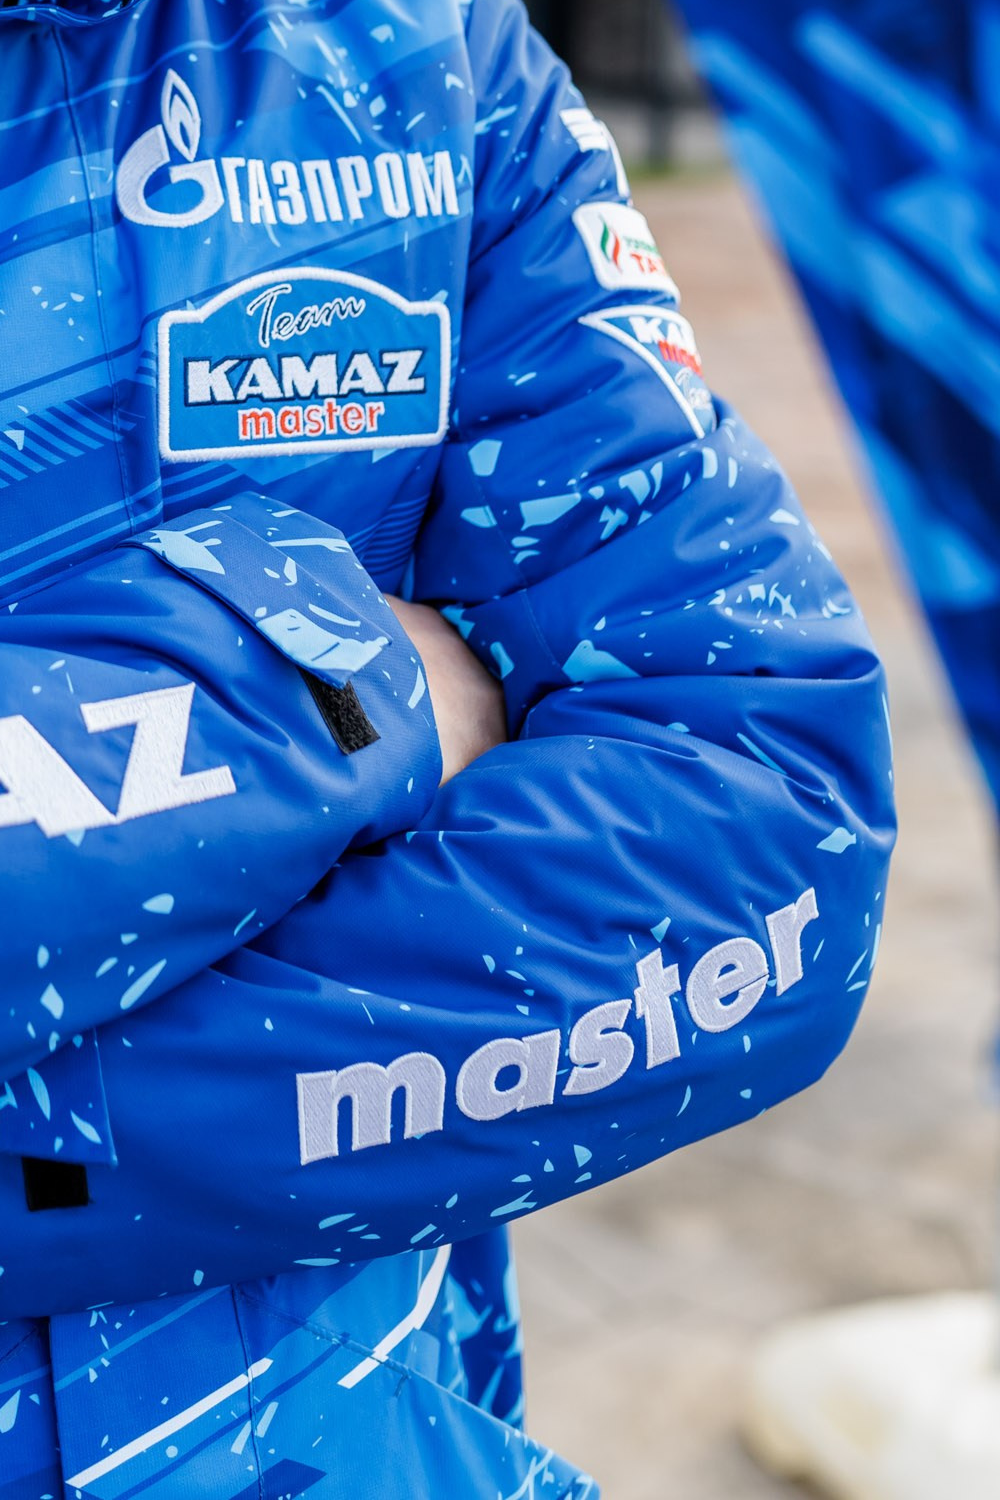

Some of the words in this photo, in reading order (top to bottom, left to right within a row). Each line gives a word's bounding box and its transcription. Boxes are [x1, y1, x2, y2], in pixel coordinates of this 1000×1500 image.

[221, 150, 460, 225] ГАЗПРОМ
[246, 283, 366, 348] Team
[186, 350, 426, 405] KAMAZ
[237, 398, 385, 441] master
[296, 887, 820, 1167] master
